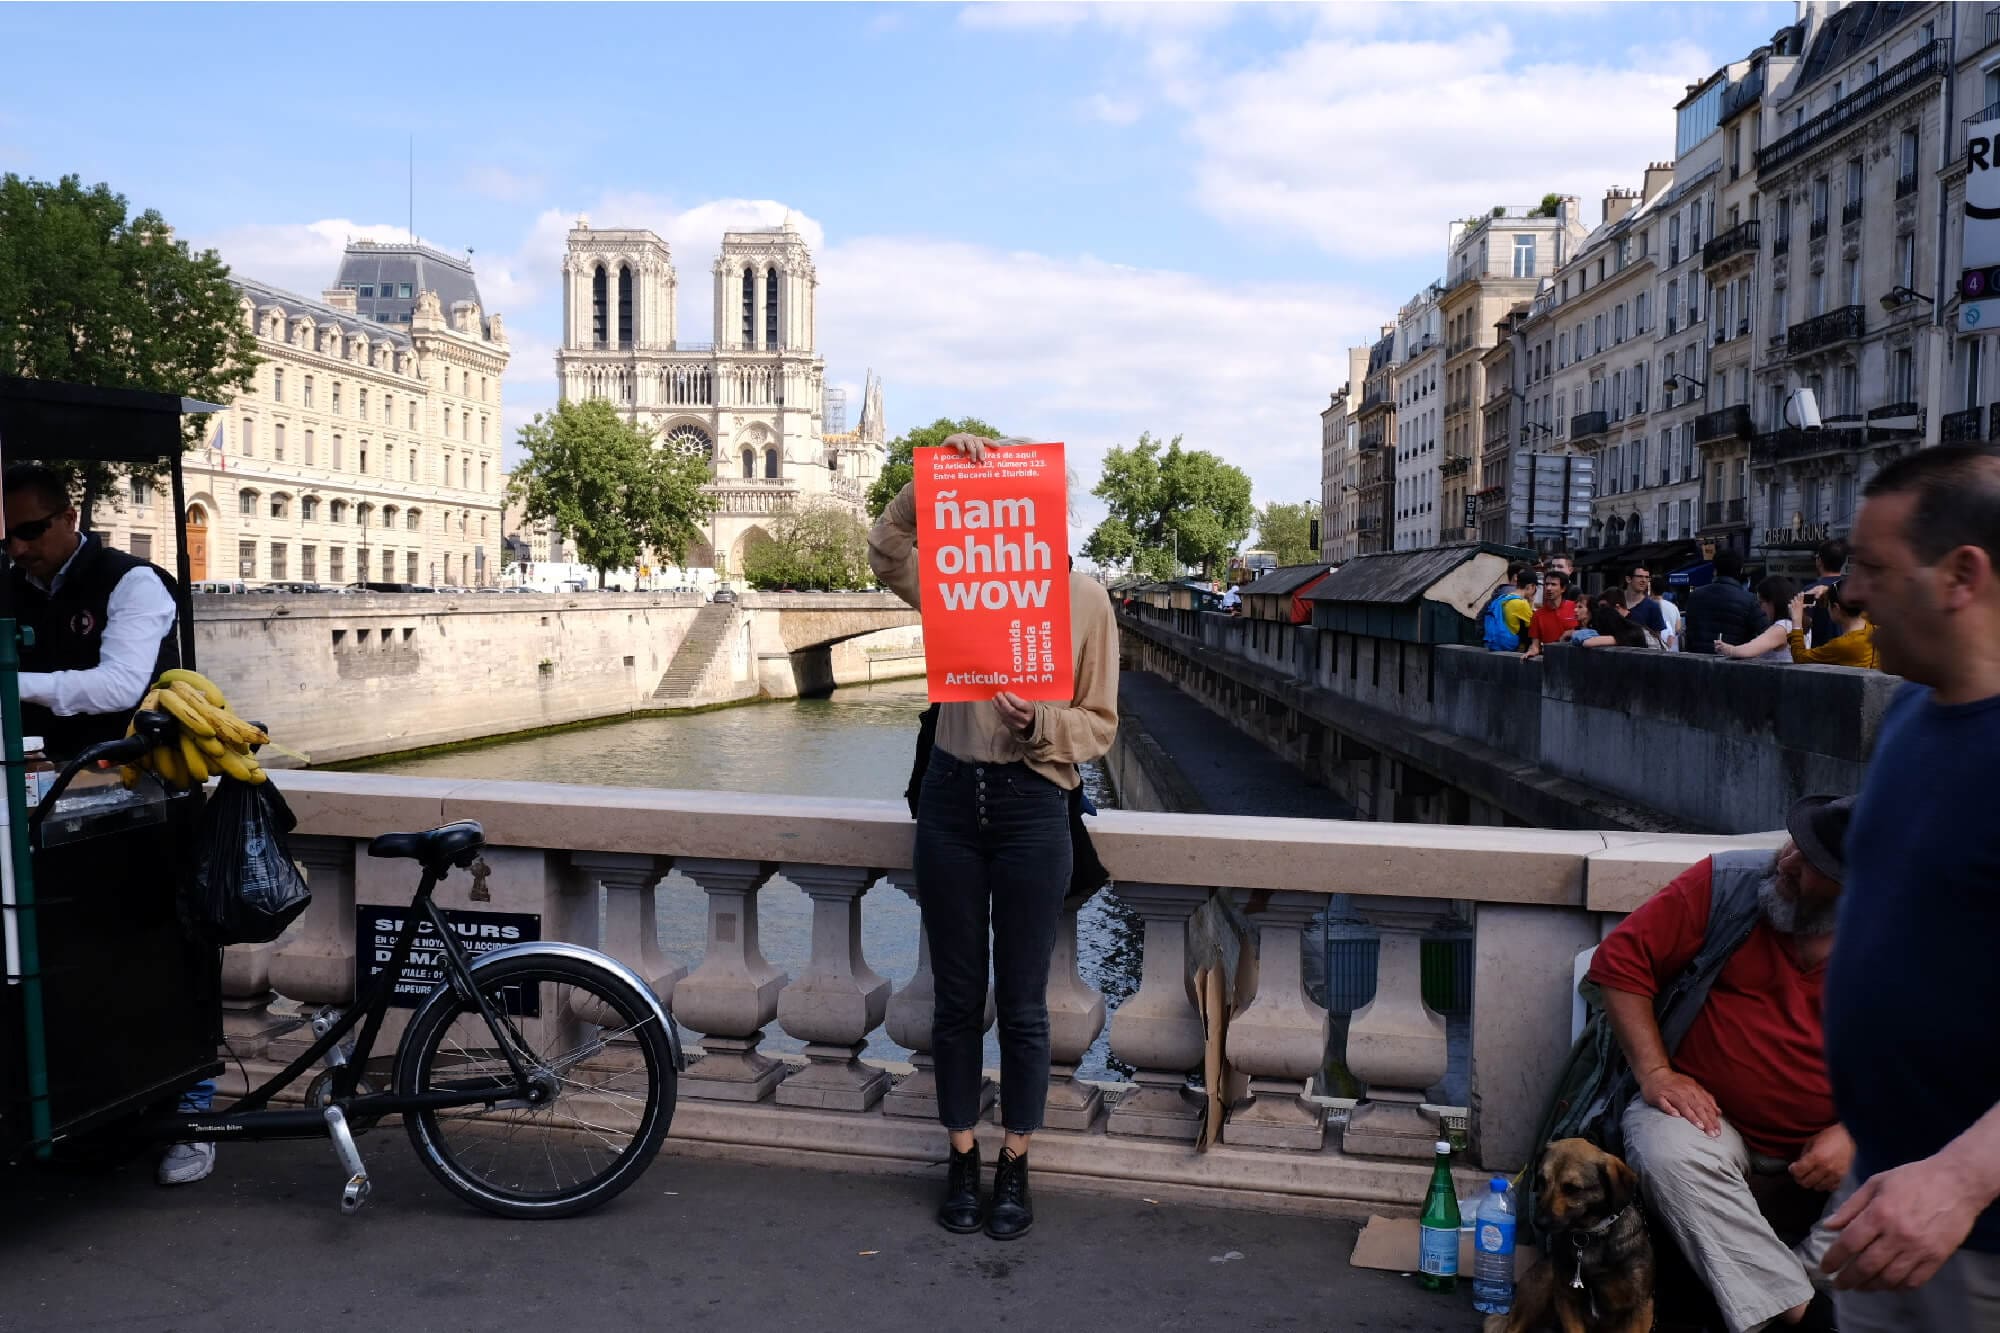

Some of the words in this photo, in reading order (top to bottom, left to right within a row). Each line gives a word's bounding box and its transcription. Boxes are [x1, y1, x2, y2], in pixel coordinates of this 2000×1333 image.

[1969, 276, 1979, 291] 4
[1003, 451, 1013, 459] de
[934, 489, 1035, 530] ñam
[935, 532, 1052, 574] ohhh
[938, 579, 1052, 611] wow
[1009, 619, 1022, 672] comida
[1025, 625, 1037, 672] tienda
[945, 671, 1009, 685] Artículo
[1010, 674, 1024, 683] 1
[1026, 674, 1038, 683] 2
[1042, 674, 1053, 683] 3
[375, 918, 521, 939] SECURS
[375, 934, 387, 944] EN
